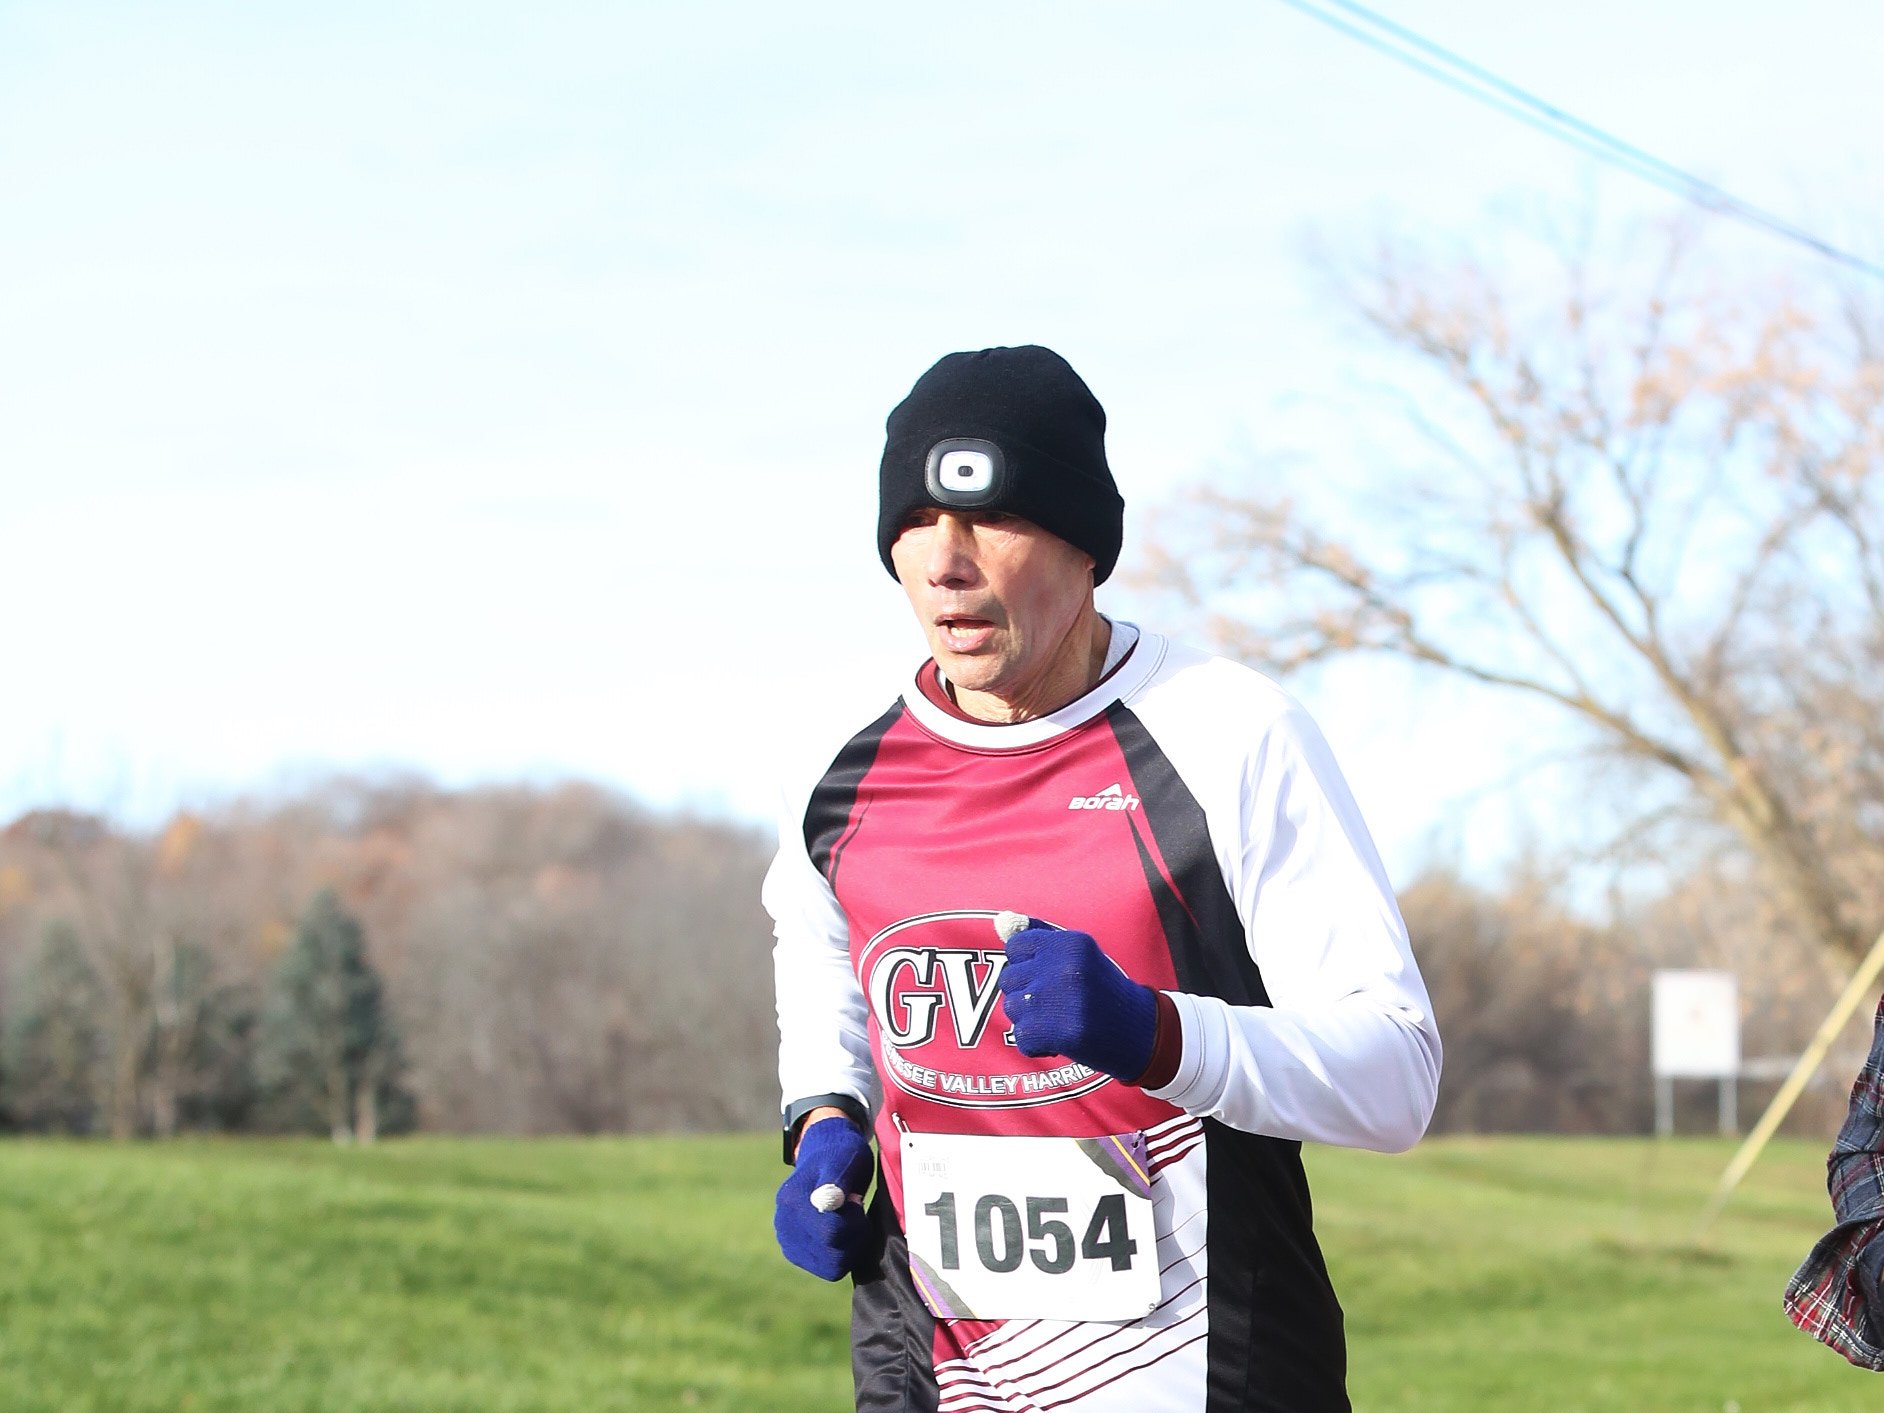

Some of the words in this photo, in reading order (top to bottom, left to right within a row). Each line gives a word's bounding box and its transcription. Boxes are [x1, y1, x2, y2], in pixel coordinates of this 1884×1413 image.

[869, 946, 1017, 1048] GV
[939, 1072, 1018, 1094] VALLEY
[1021, 1062, 1096, 1093] HARRIE
[925, 1191, 1138, 1275] 1054
